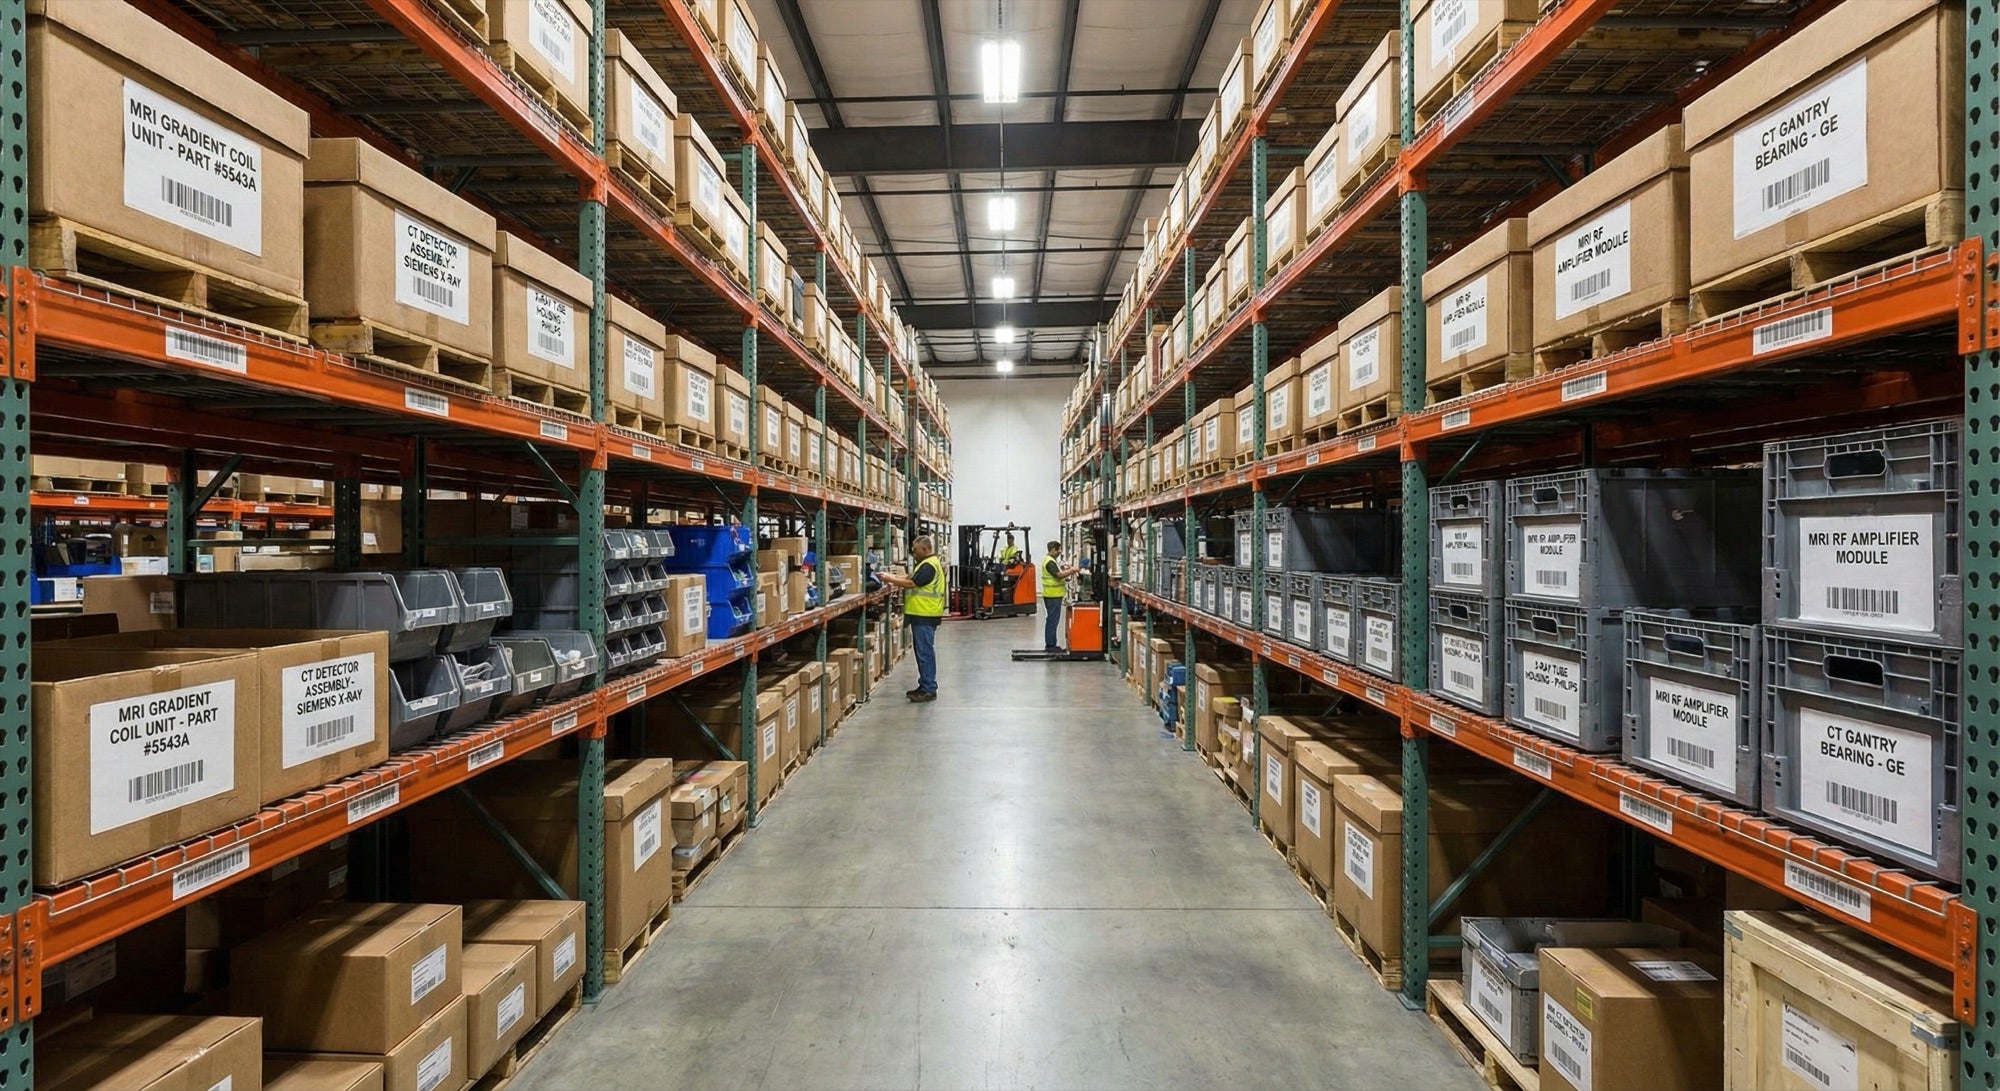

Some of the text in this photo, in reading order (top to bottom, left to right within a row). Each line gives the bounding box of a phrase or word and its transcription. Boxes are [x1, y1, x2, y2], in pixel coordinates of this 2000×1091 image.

[130, 98, 256, 172] MRI GRADIENT COIL
[1762, 96, 1830, 146] CT GANTRY
[1756, 132, 1808, 170] BEARING
[1820, 114, 1838, 137] GE
[132, 122, 164, 150] UNIT
[178, 143, 210, 170] PART
[214, 160, 256, 192] #5543A
[408, 225, 457, 258] CT DETECTOR
[1594, 226, 1603, 242] RF
[1595, 230, 1628, 257] MODULE
[1808, 532, 1920, 545] MRI RF AMPLIFIER
[1836, 551, 1888, 564] MODULE
[301, 661, 359, 682] CT DETECTOR
[119, 691, 211, 722] MRI GRADIENT
[297, 695, 336, 715] SIEMENS
[1656, 690, 1729, 719] MRI RF AMPLIFIER
[1673, 708, 1708, 728] MODULE
[110, 725, 142, 744] COIL
[146, 717, 176, 736] UNIT
[188, 708, 218, 727] PART
[1827, 725, 1897, 753] CT GANTRY
[144, 733, 190, 756] #5543A
[1821, 741, 1874, 767] BEARING
[1886, 759, 1905, 776] GE
